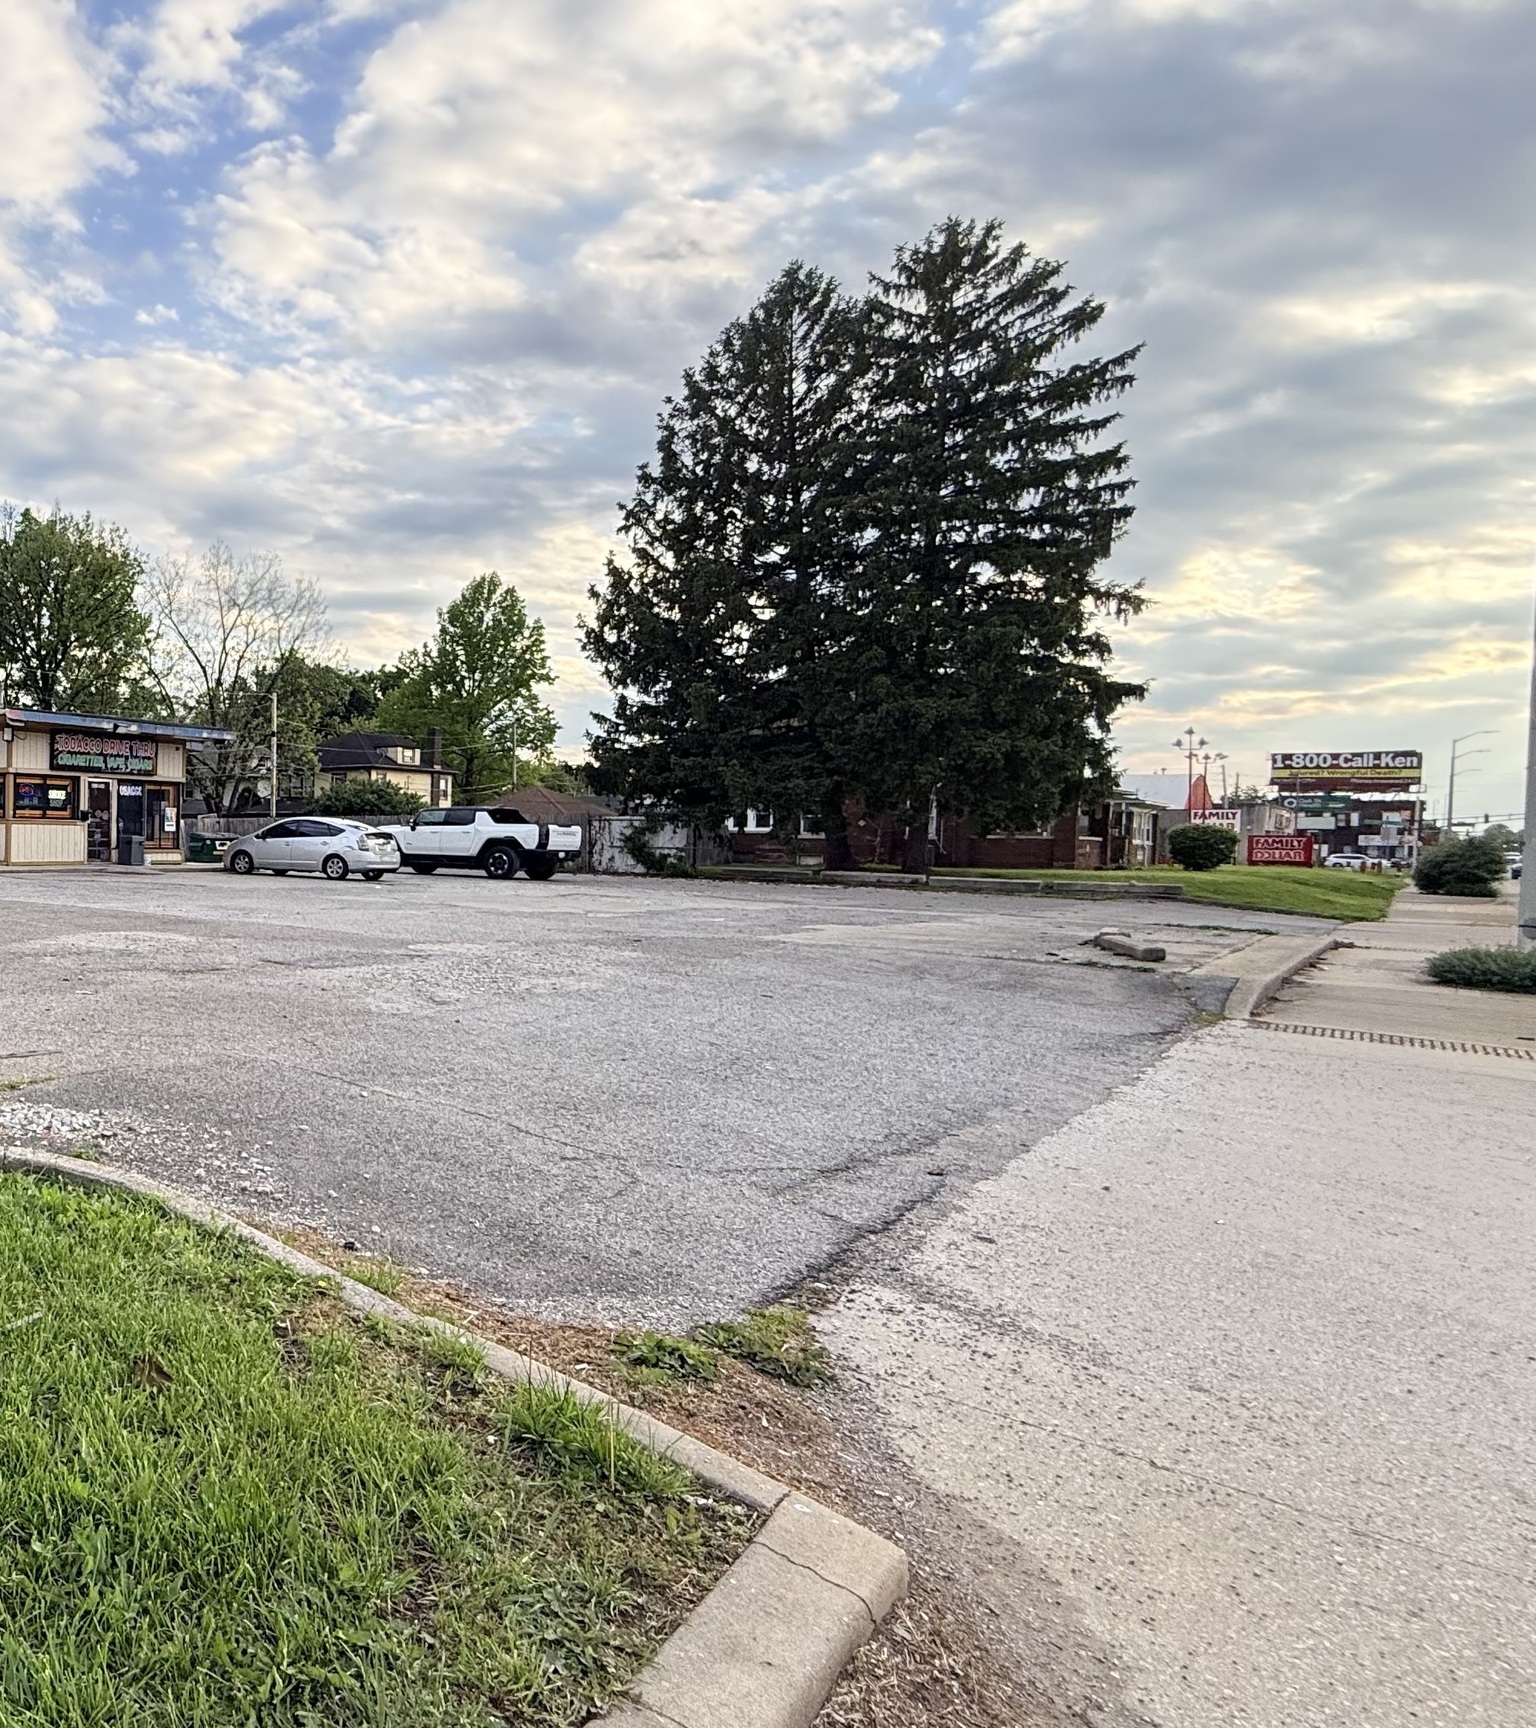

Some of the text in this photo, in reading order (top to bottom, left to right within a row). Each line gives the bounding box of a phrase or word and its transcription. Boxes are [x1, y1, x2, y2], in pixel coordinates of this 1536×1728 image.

[56, 735, 155, 757] TOBACCO DRIVE THRU
[1273, 753, 1418, 768] 1-800-Call-Ken
[1327, 769, 1369, 777] Wrongful
[1193, 811, 1238, 820] FAMILY
[1253, 838, 1305, 848] FAMILY
[1253, 849, 1305, 861] DOLLAR
